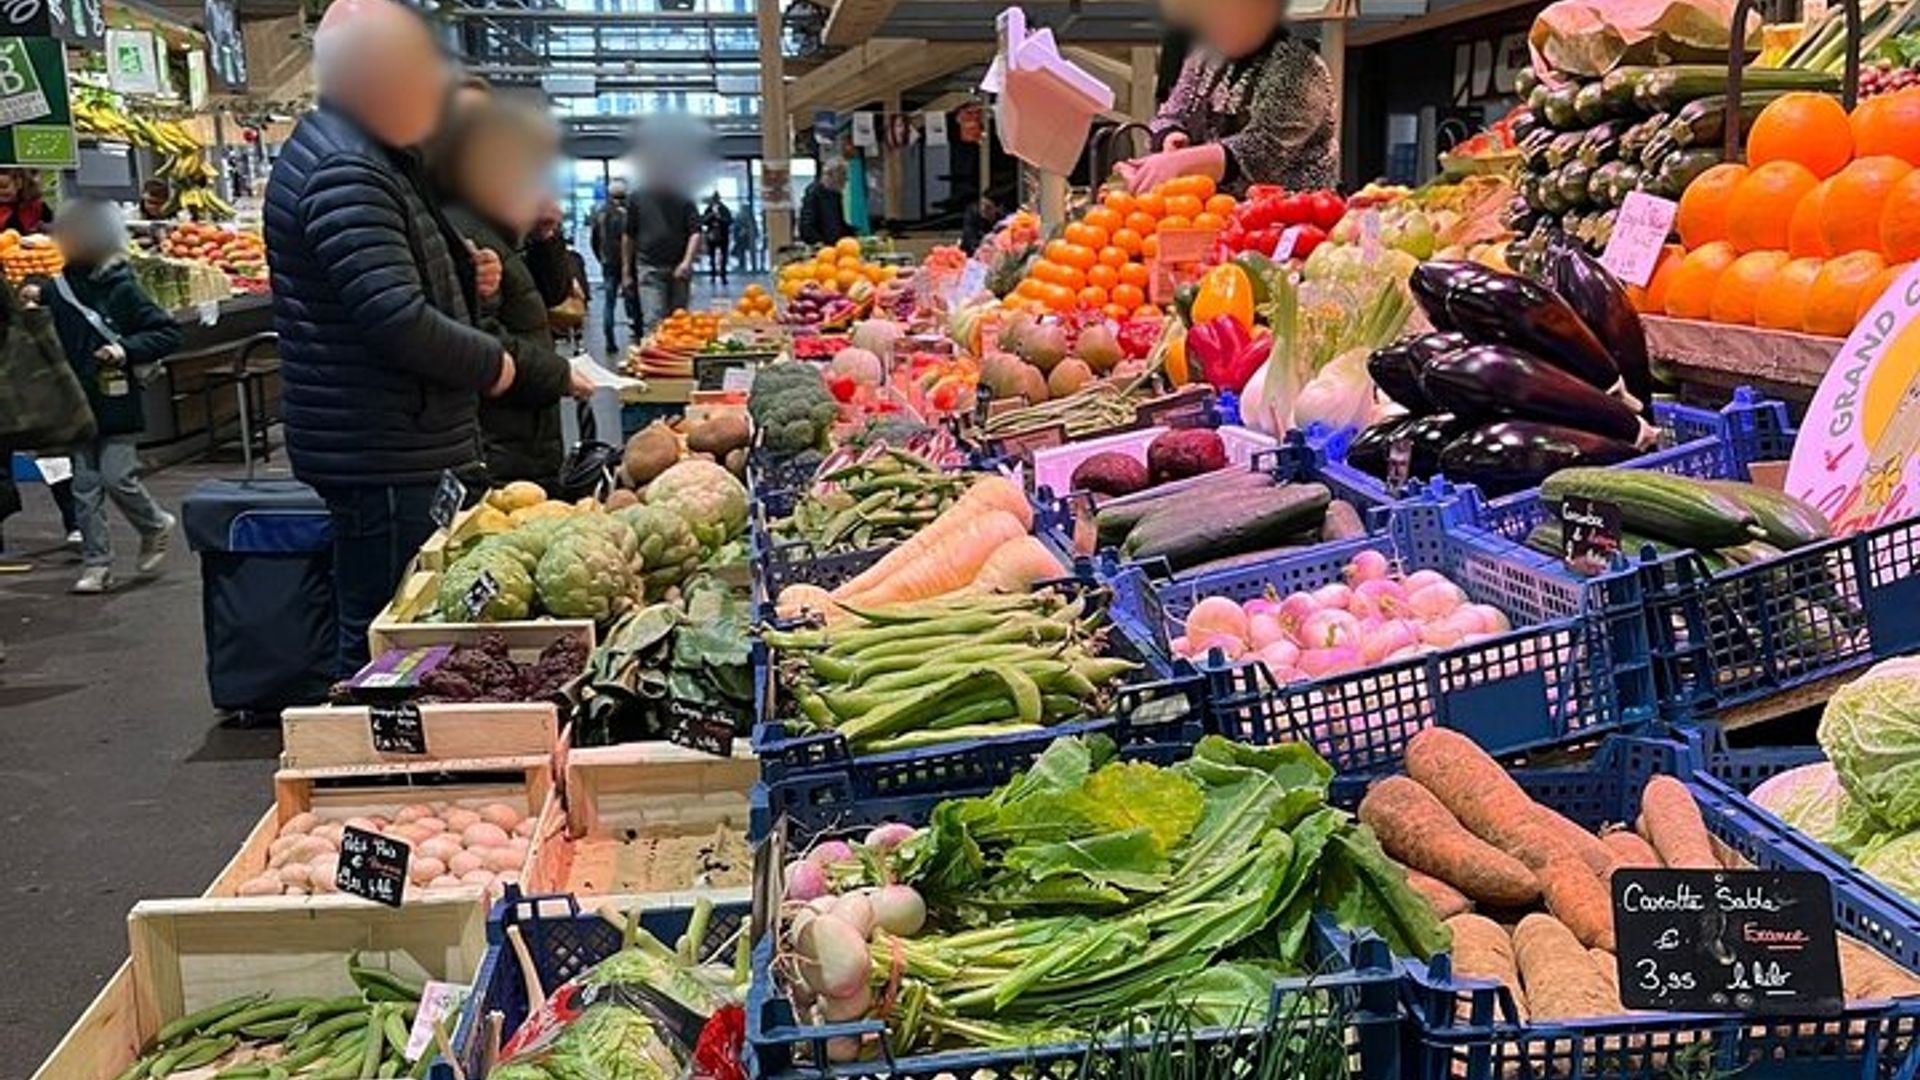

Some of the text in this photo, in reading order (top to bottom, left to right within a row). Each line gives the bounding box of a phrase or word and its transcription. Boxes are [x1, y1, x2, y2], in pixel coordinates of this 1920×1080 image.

[1829, 310, 1896, 438] GRAND
[1623, 881, 1704, 912] Carotte
[1743, 921, 1809, 943] France
[1635, 958, 1697, 997] 3,95
